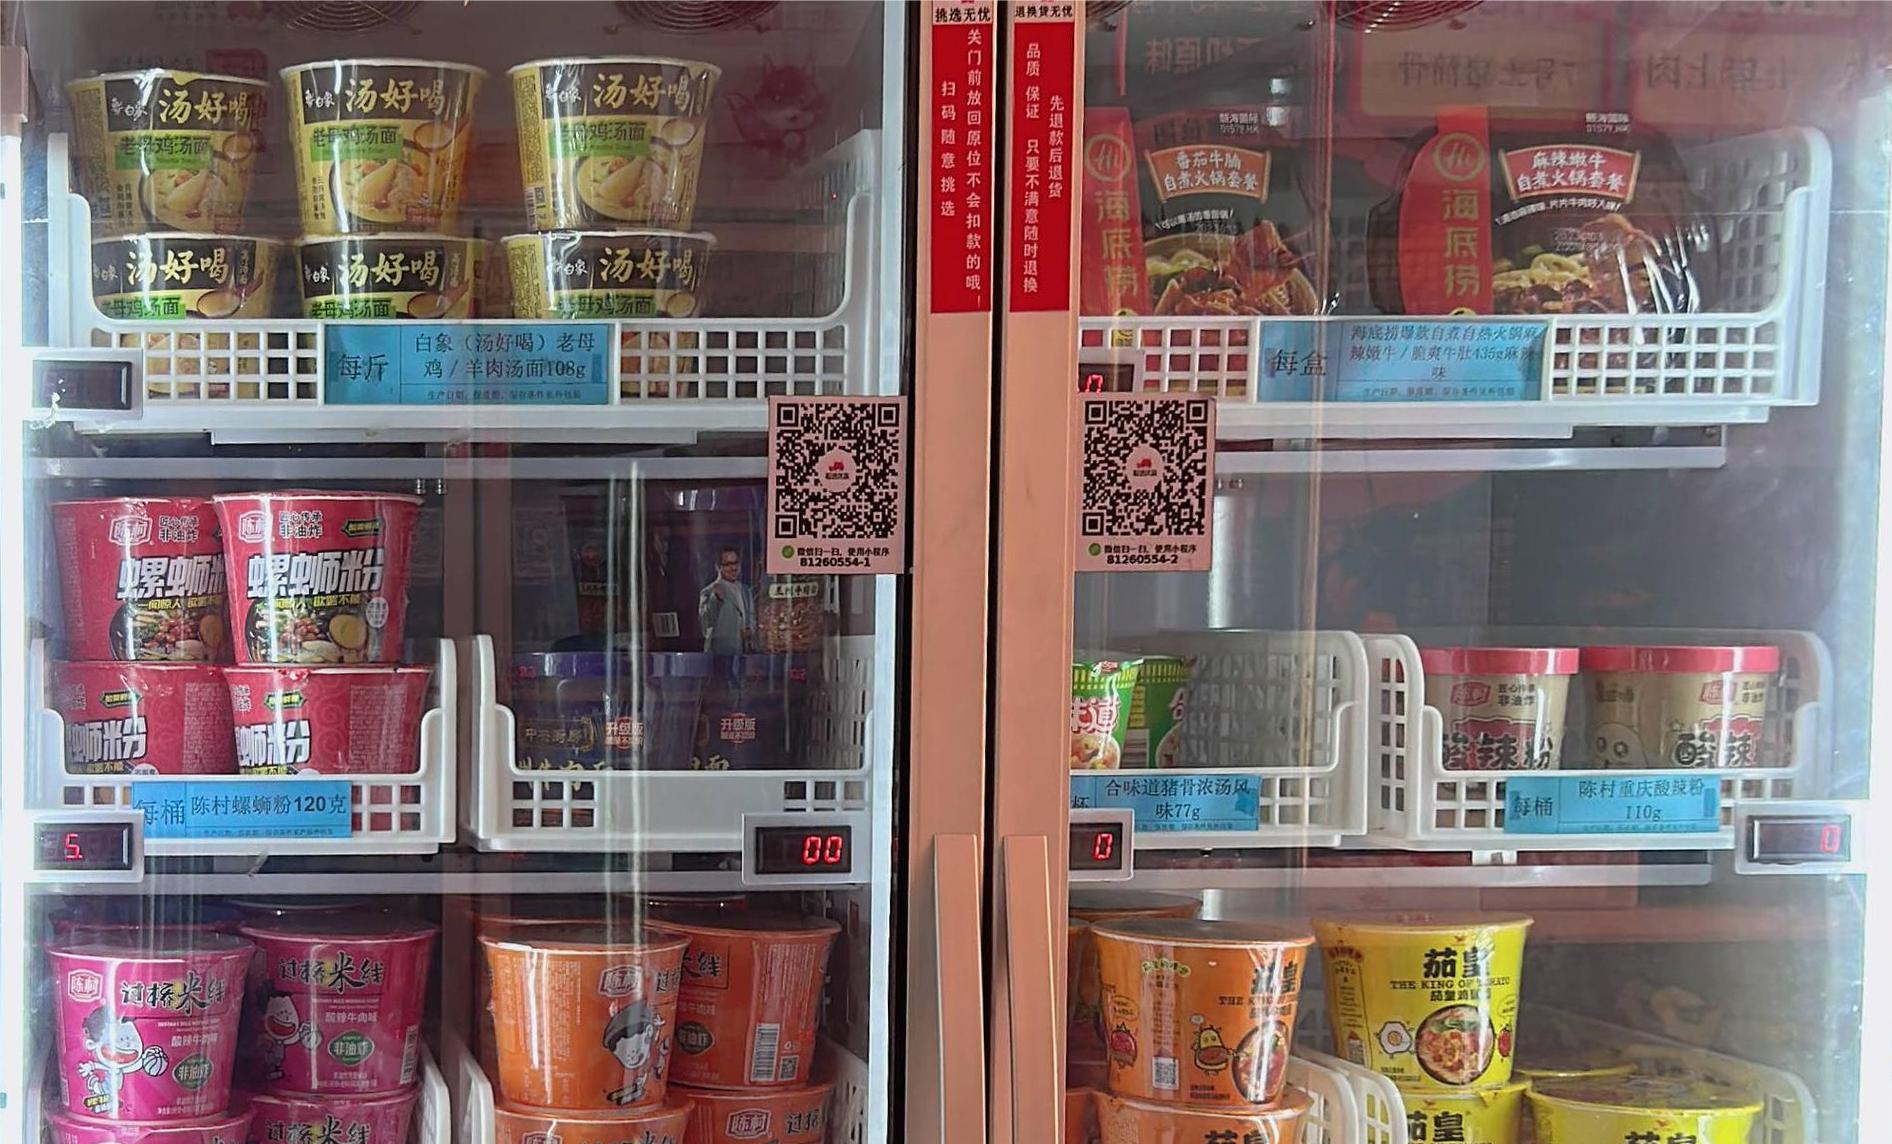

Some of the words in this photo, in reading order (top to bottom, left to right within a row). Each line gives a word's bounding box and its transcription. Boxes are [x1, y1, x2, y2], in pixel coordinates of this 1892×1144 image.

[935, 7, 991, 22] 挑选无忧
[1015, 5, 1073, 18] 退换货无忧
[158, 87, 250, 126] 汤好喝
[345, 78, 445, 116] 汤好喝
[593, 73, 691, 118] 汤好喝
[312, 125, 398, 147] 老母鸡汤面
[1048, 95, 1064, 198] 先退款后退货
[940, 81, 956, 217] 扫码随意挑选
[1532, 149, 1606, 169] 麻辣嫩牛
[1163, 170, 1257, 191] 自煮火锅套餐
[1516, 170, 1625, 191] 自煮火锅套餐
[1442, 189, 1480, 297] 海底捞
[126, 248, 229, 287] 汤好喝
[338, 250, 439, 287] 汤好喝
[599, 247, 697, 290] 汤好喝
[337, 353, 389, 381] 每斤
[1274, 349, 1327, 377] 每盒
[159, 528, 198, 541] 非油炸
[279, 524, 322, 539] 非油炸
[800, 557, 871, 567] 81260554-1
[1107, 554, 1178, 565] 81260554-2
[720, 718, 756, 730] 升级版
[1105, 778, 1250, 797] 合味道猪骨浓汤风
[1579, 779, 1704, 798] 陈村重庆酸辣粉
[1155, 802, 1201, 821] 味77g
[1514, 796, 1553, 818] 每桶
[1625, 805, 1661, 821] 110g
[1092, 832, 1113, 860] 0
[1820, 825, 1841, 852] 0
[803, 836, 843, 864] 00
[280, 951, 383, 994] 过桥米线
[121, 971, 226, 1016] 过桥米线
[1422, 981, 1453, 990] KING
